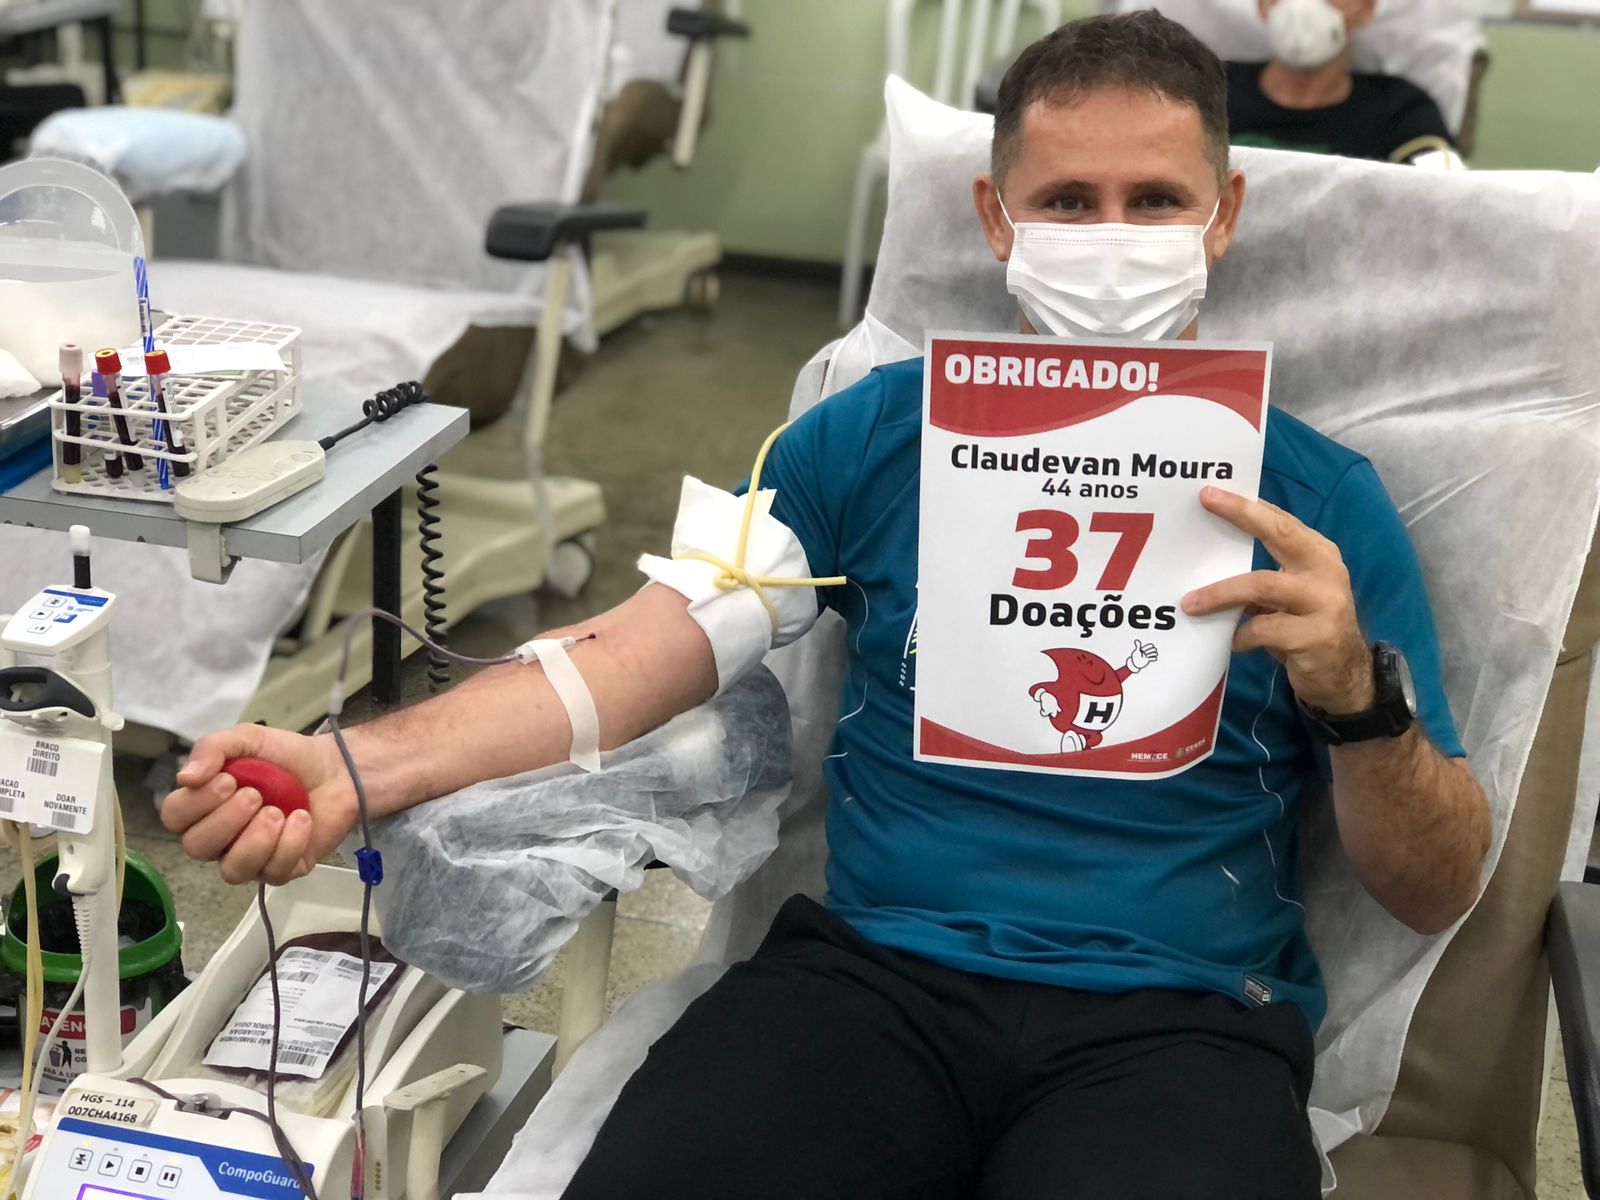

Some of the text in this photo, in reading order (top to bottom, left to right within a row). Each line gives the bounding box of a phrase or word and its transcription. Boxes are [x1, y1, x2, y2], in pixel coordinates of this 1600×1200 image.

[944, 354, 1160, 392] OBRIGADO!
[951, 444, 1234, 480] Claudevan Moura
[1041, 478, 1138, 499] 44 anos
[1011, 509, 1154, 591] 37
[990, 594, 1176, 637] Doações
[1084, 702, 1114, 723] H
[32, 749, 60, 761] DIREITO
[35, 741, 59, 752] BRACO
[43, 801, 87, 815] NOVAMENTE
[56, 793, 76, 804] DOAR
[80, 1094, 104, 1104] HGS
[115, 1098, 135, 1108] 114
[68, 1105, 137, 1123] 007CHA4168
